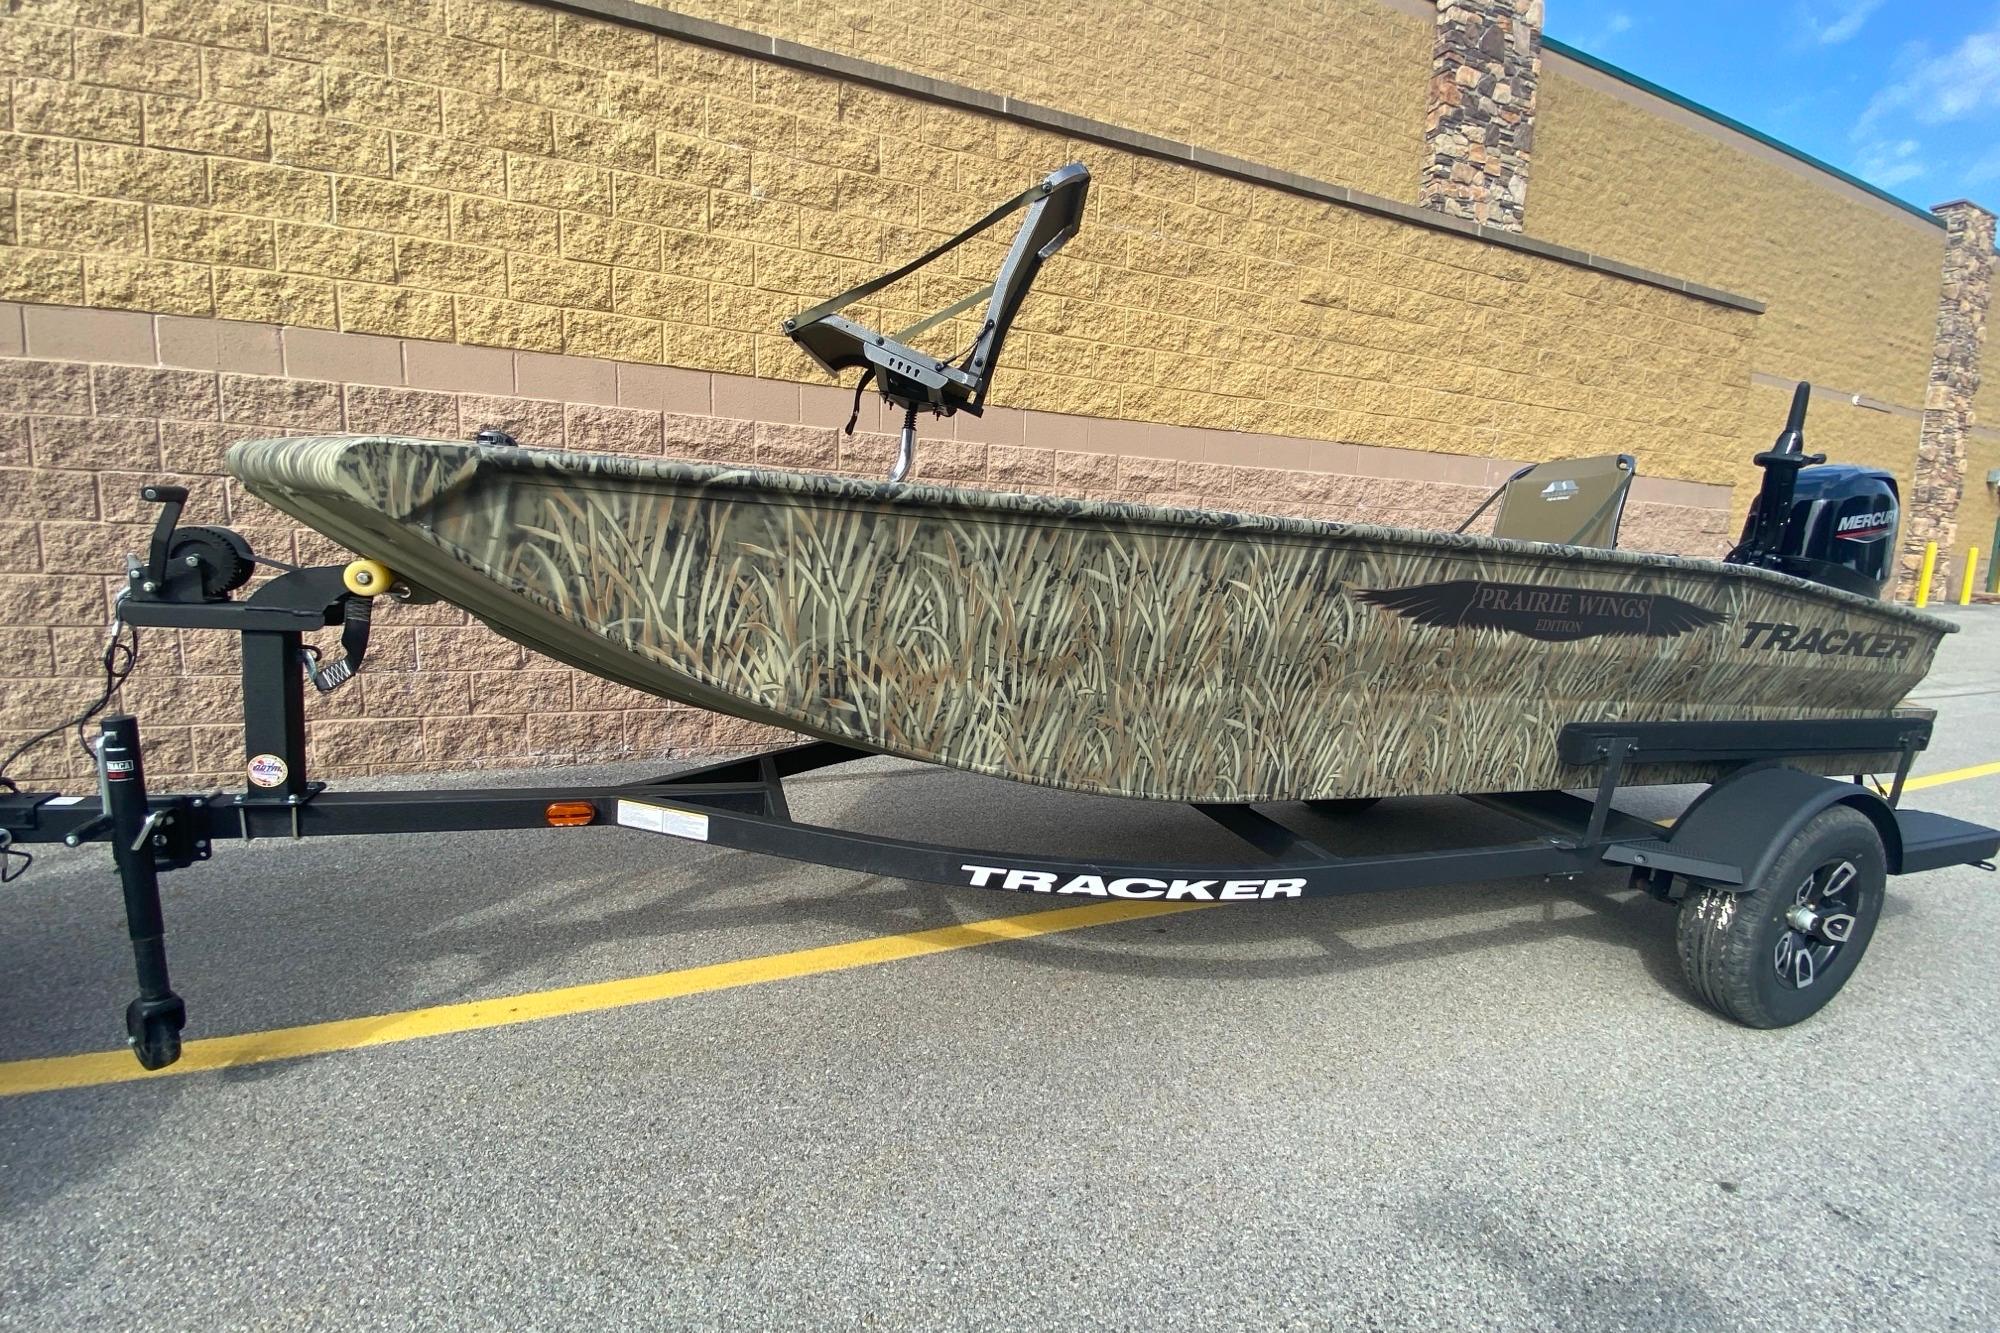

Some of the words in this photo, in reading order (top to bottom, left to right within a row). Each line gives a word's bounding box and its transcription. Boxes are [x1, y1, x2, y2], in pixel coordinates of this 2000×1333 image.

[1479, 589, 1572, 612] PRAIRIE
[1579, 595, 1649, 619] WINGS
[1536, 619, 1583, 633] EDITION
[1740, 622, 1915, 659] TRACKER
[962, 865, 1307, 900] TRACKER
